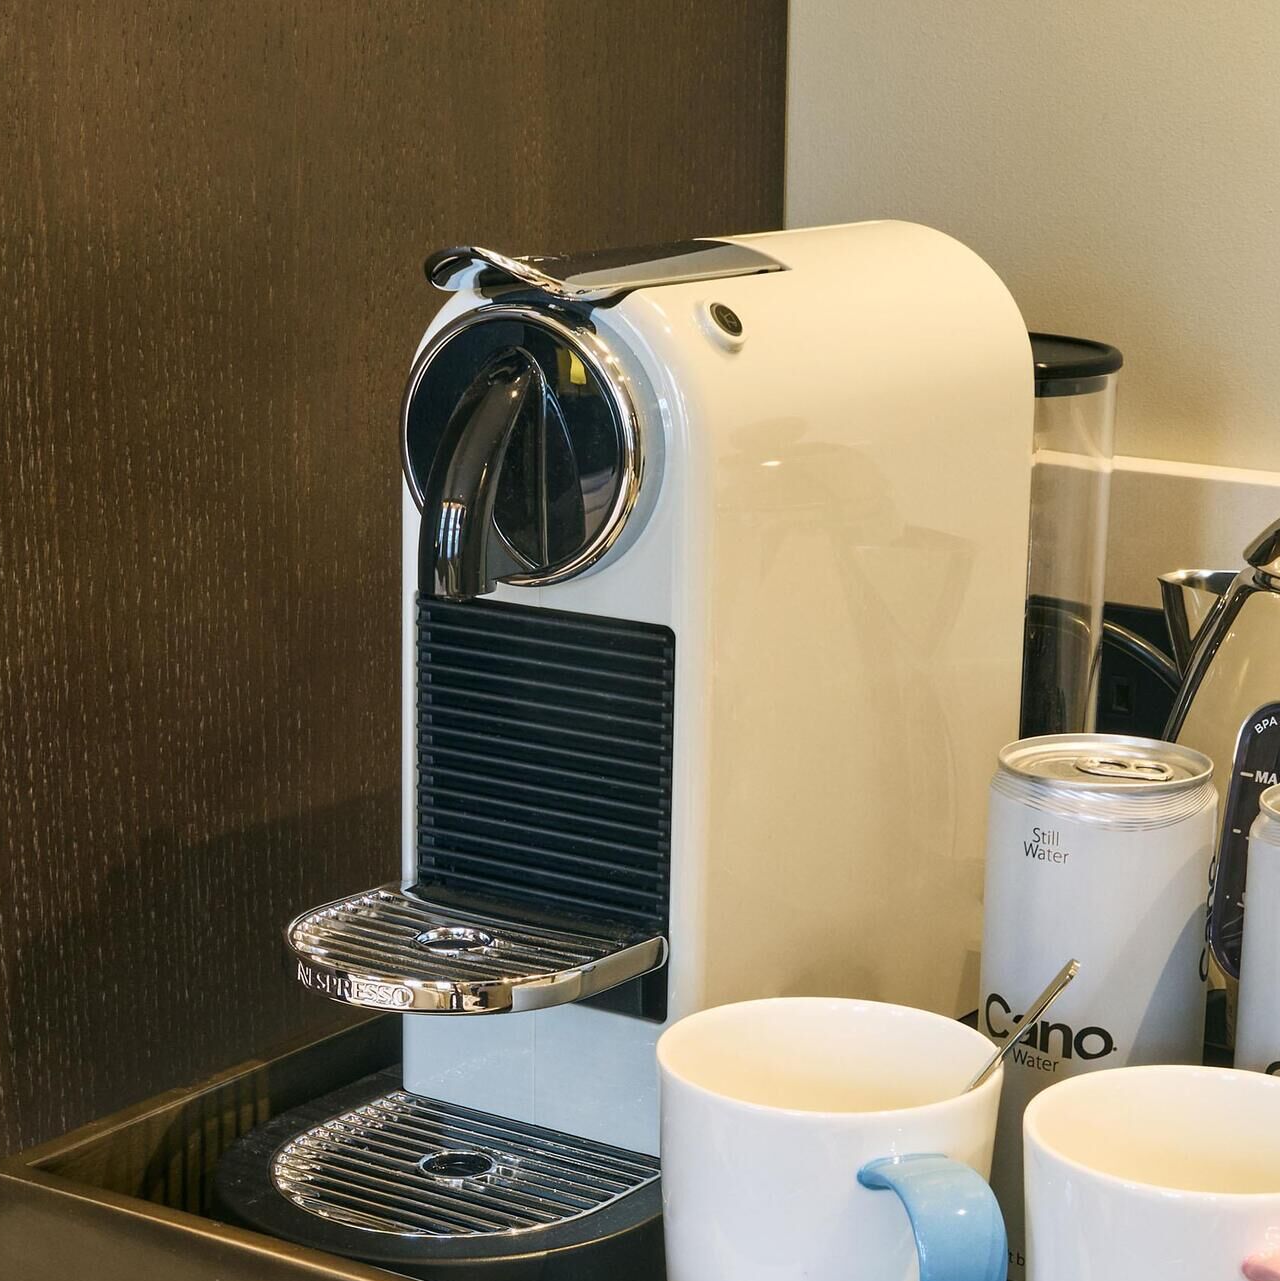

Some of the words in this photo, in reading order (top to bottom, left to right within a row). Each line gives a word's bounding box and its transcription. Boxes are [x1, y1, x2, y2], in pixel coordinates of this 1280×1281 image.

[1254, 716, 1278, 734] BPA
[1032, 827, 1060, 846] Still
[1023, 841, 1070, 865] Water
[1012, 1048, 1060, 1073] Water
